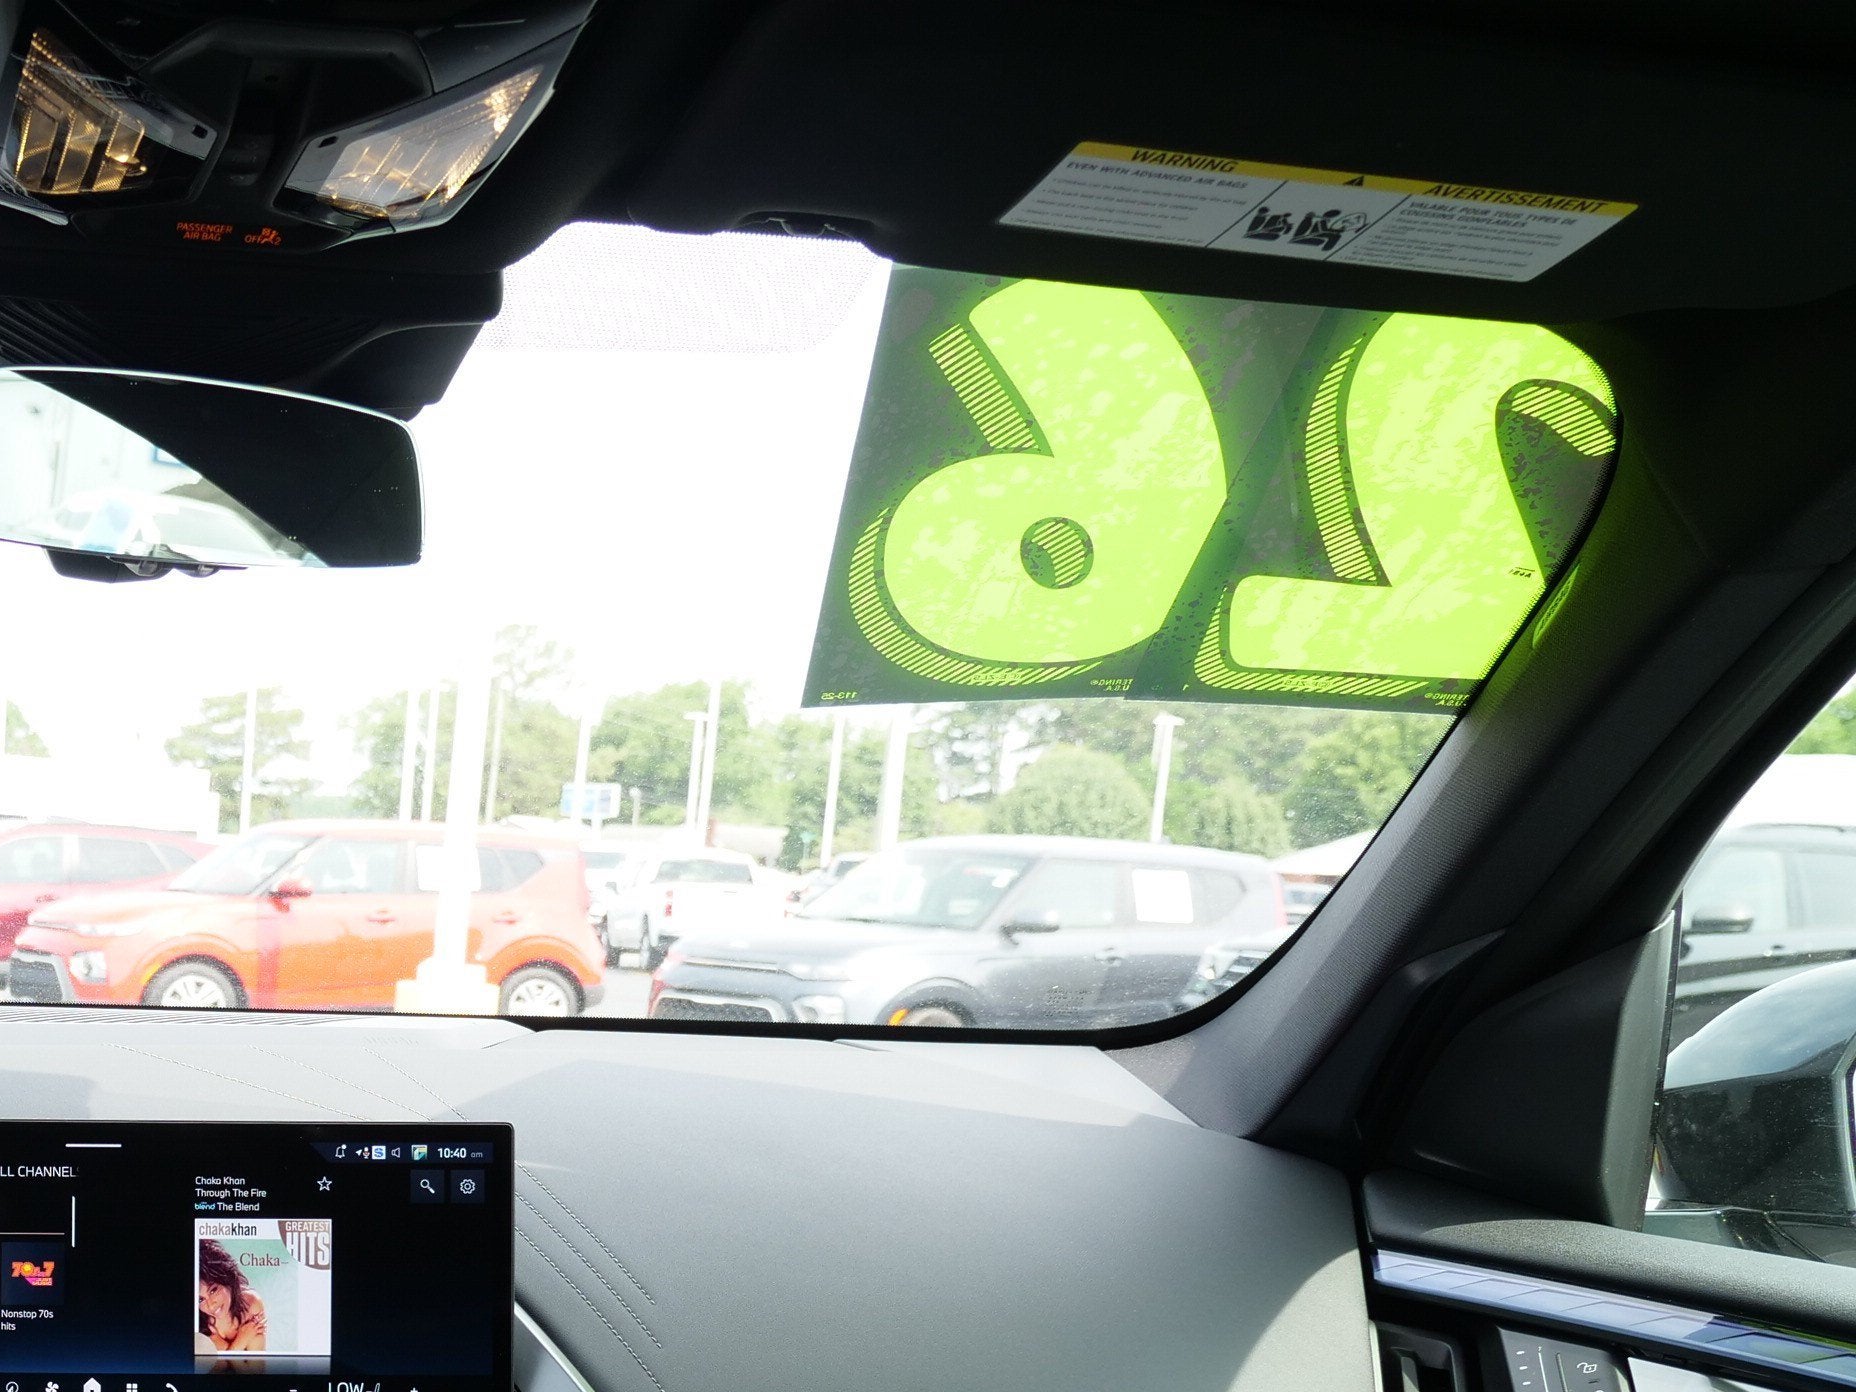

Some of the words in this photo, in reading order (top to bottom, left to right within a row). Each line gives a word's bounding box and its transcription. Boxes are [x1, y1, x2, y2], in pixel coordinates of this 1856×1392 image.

[1130, 149, 1240, 174] WARNING
[1066, 161, 1097, 171] EVEN
[1100, 165, 1129, 175] WITH
[1132, 168, 1192, 183] ADVANCED
[1197, 177, 1214, 186] AIR
[1217, 179, 1248, 189] BAGS
[1422, 183, 1609, 215] AVERTISSEMENT
[1399, 210, 1453, 223] COUSSINS
[1456, 215, 1529, 228] GONFLABLES
[1409, 201, 1456, 213] VALABLE
[1461, 205, 1491, 216] POUR
[1494, 210, 1523, 219] TOUS
[1526, 213, 1559, 224] TYPES
[1561, 216, 1579, 225] DE
[176, 222, 233, 234] PASSENGER
[183, 231, 200, 240] AIR
[202, 233, 222, 242] BAG
[437, 1148, 467, 1159] 10:40
[18, 1166, 80, 1178] CHANNEL
[195, 1176, 221, 1185] Chaka
[223, 1176, 245, 1185] Khan
[195, 1189, 230, 1199] Through
[232, 1189, 249, 1197] The
[250, 1189, 267, 1197] Fire
[217, 1202, 233, 1211] The
[235, 1203, 260, 1211] Blend
[285, 1222, 330, 1232] GREATEST
[286, 1232, 330, 1266] HITS
[239, 1253, 280, 1267] Chaka
[1, 1309, 36, 1320] Nonstop
[38, 1309, 54, 1318] 70s
[1, 1322, 16, 1330] hits
